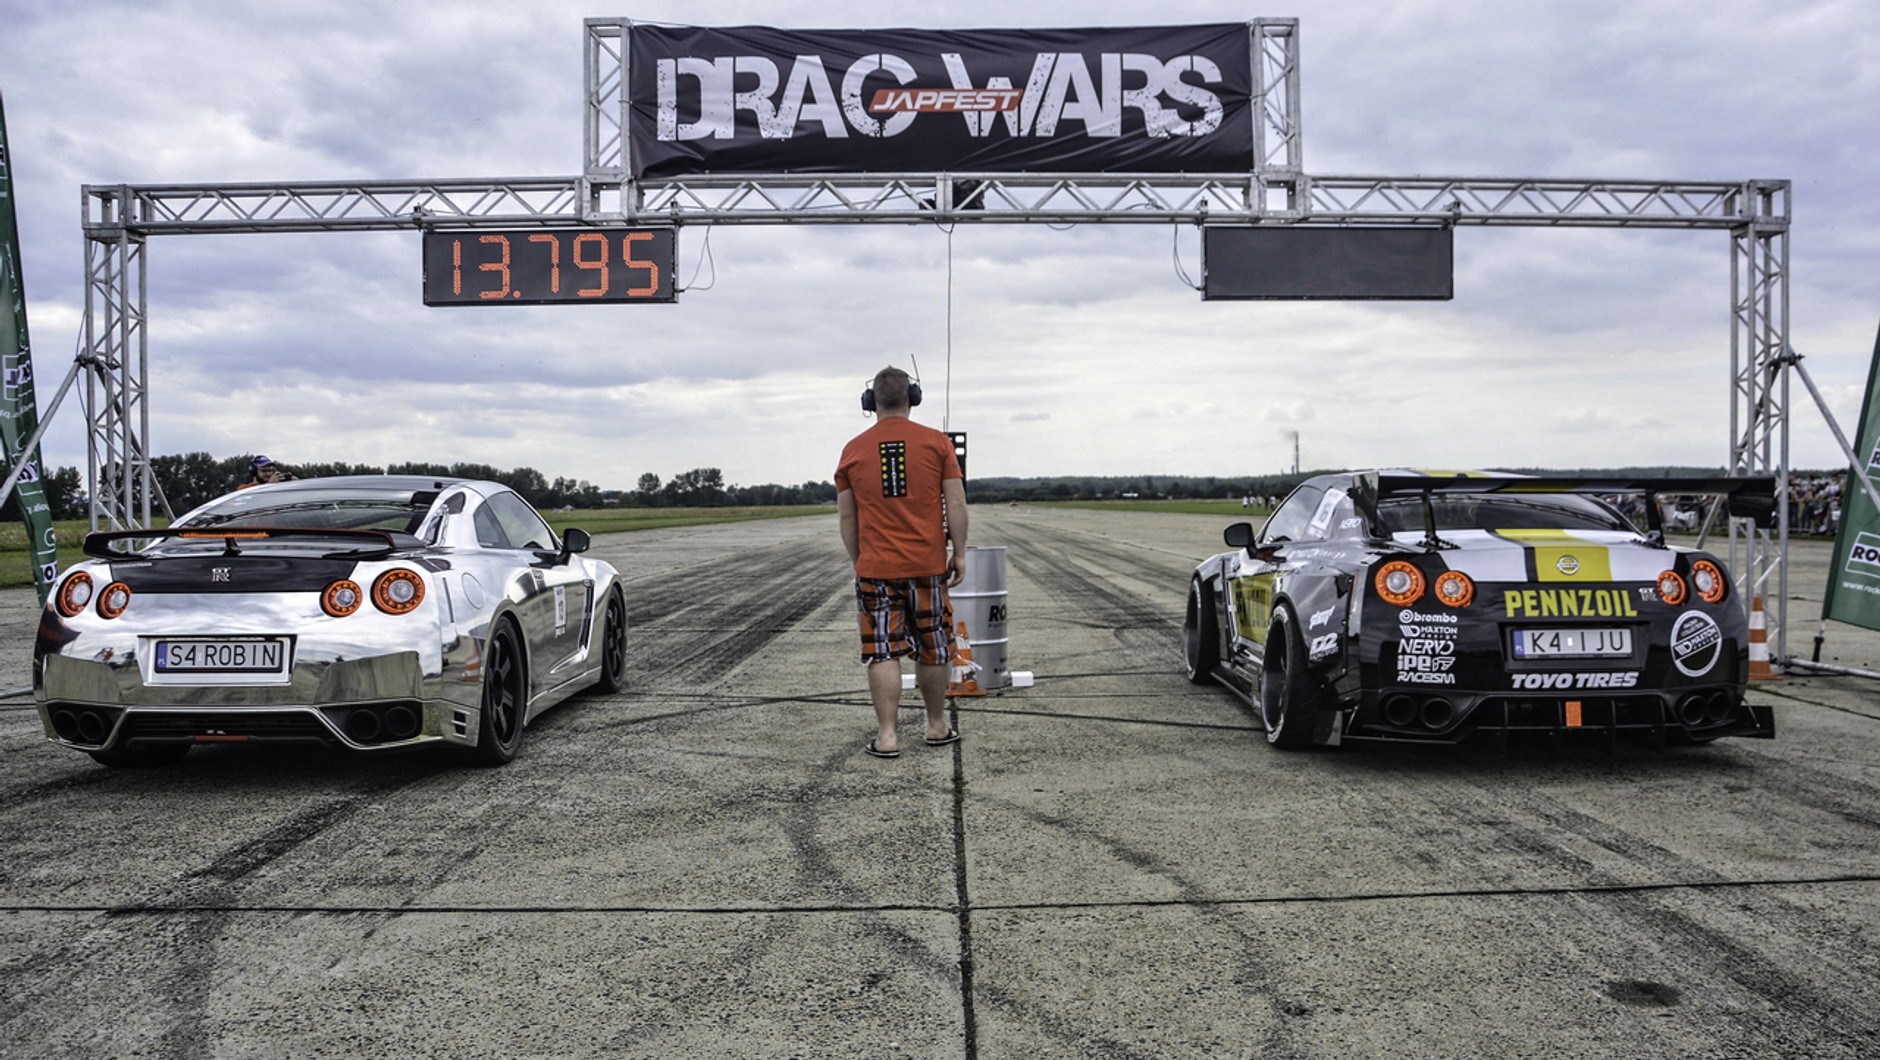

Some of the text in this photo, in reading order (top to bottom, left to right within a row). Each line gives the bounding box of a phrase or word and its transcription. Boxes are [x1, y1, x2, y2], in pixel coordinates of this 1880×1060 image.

[873, 90, 1020, 110] JAPFEST
[942, 52, 1223, 138] WARS
[453, 232, 659, 299] 13.795
[1504, 589, 1638, 617] PENNZOIL
[1414, 611, 1458, 623] brembo
[1420, 625, 1458, 634] MAXTON
[1397, 638, 1455, 655] NERVO
[1531, 631, 1561, 653] K4
[170, 644, 277, 666] S4 ROBIN
[1397, 671, 1456, 684] RACEISM
[1511, 671, 1639, 689] TOYO TIRES
